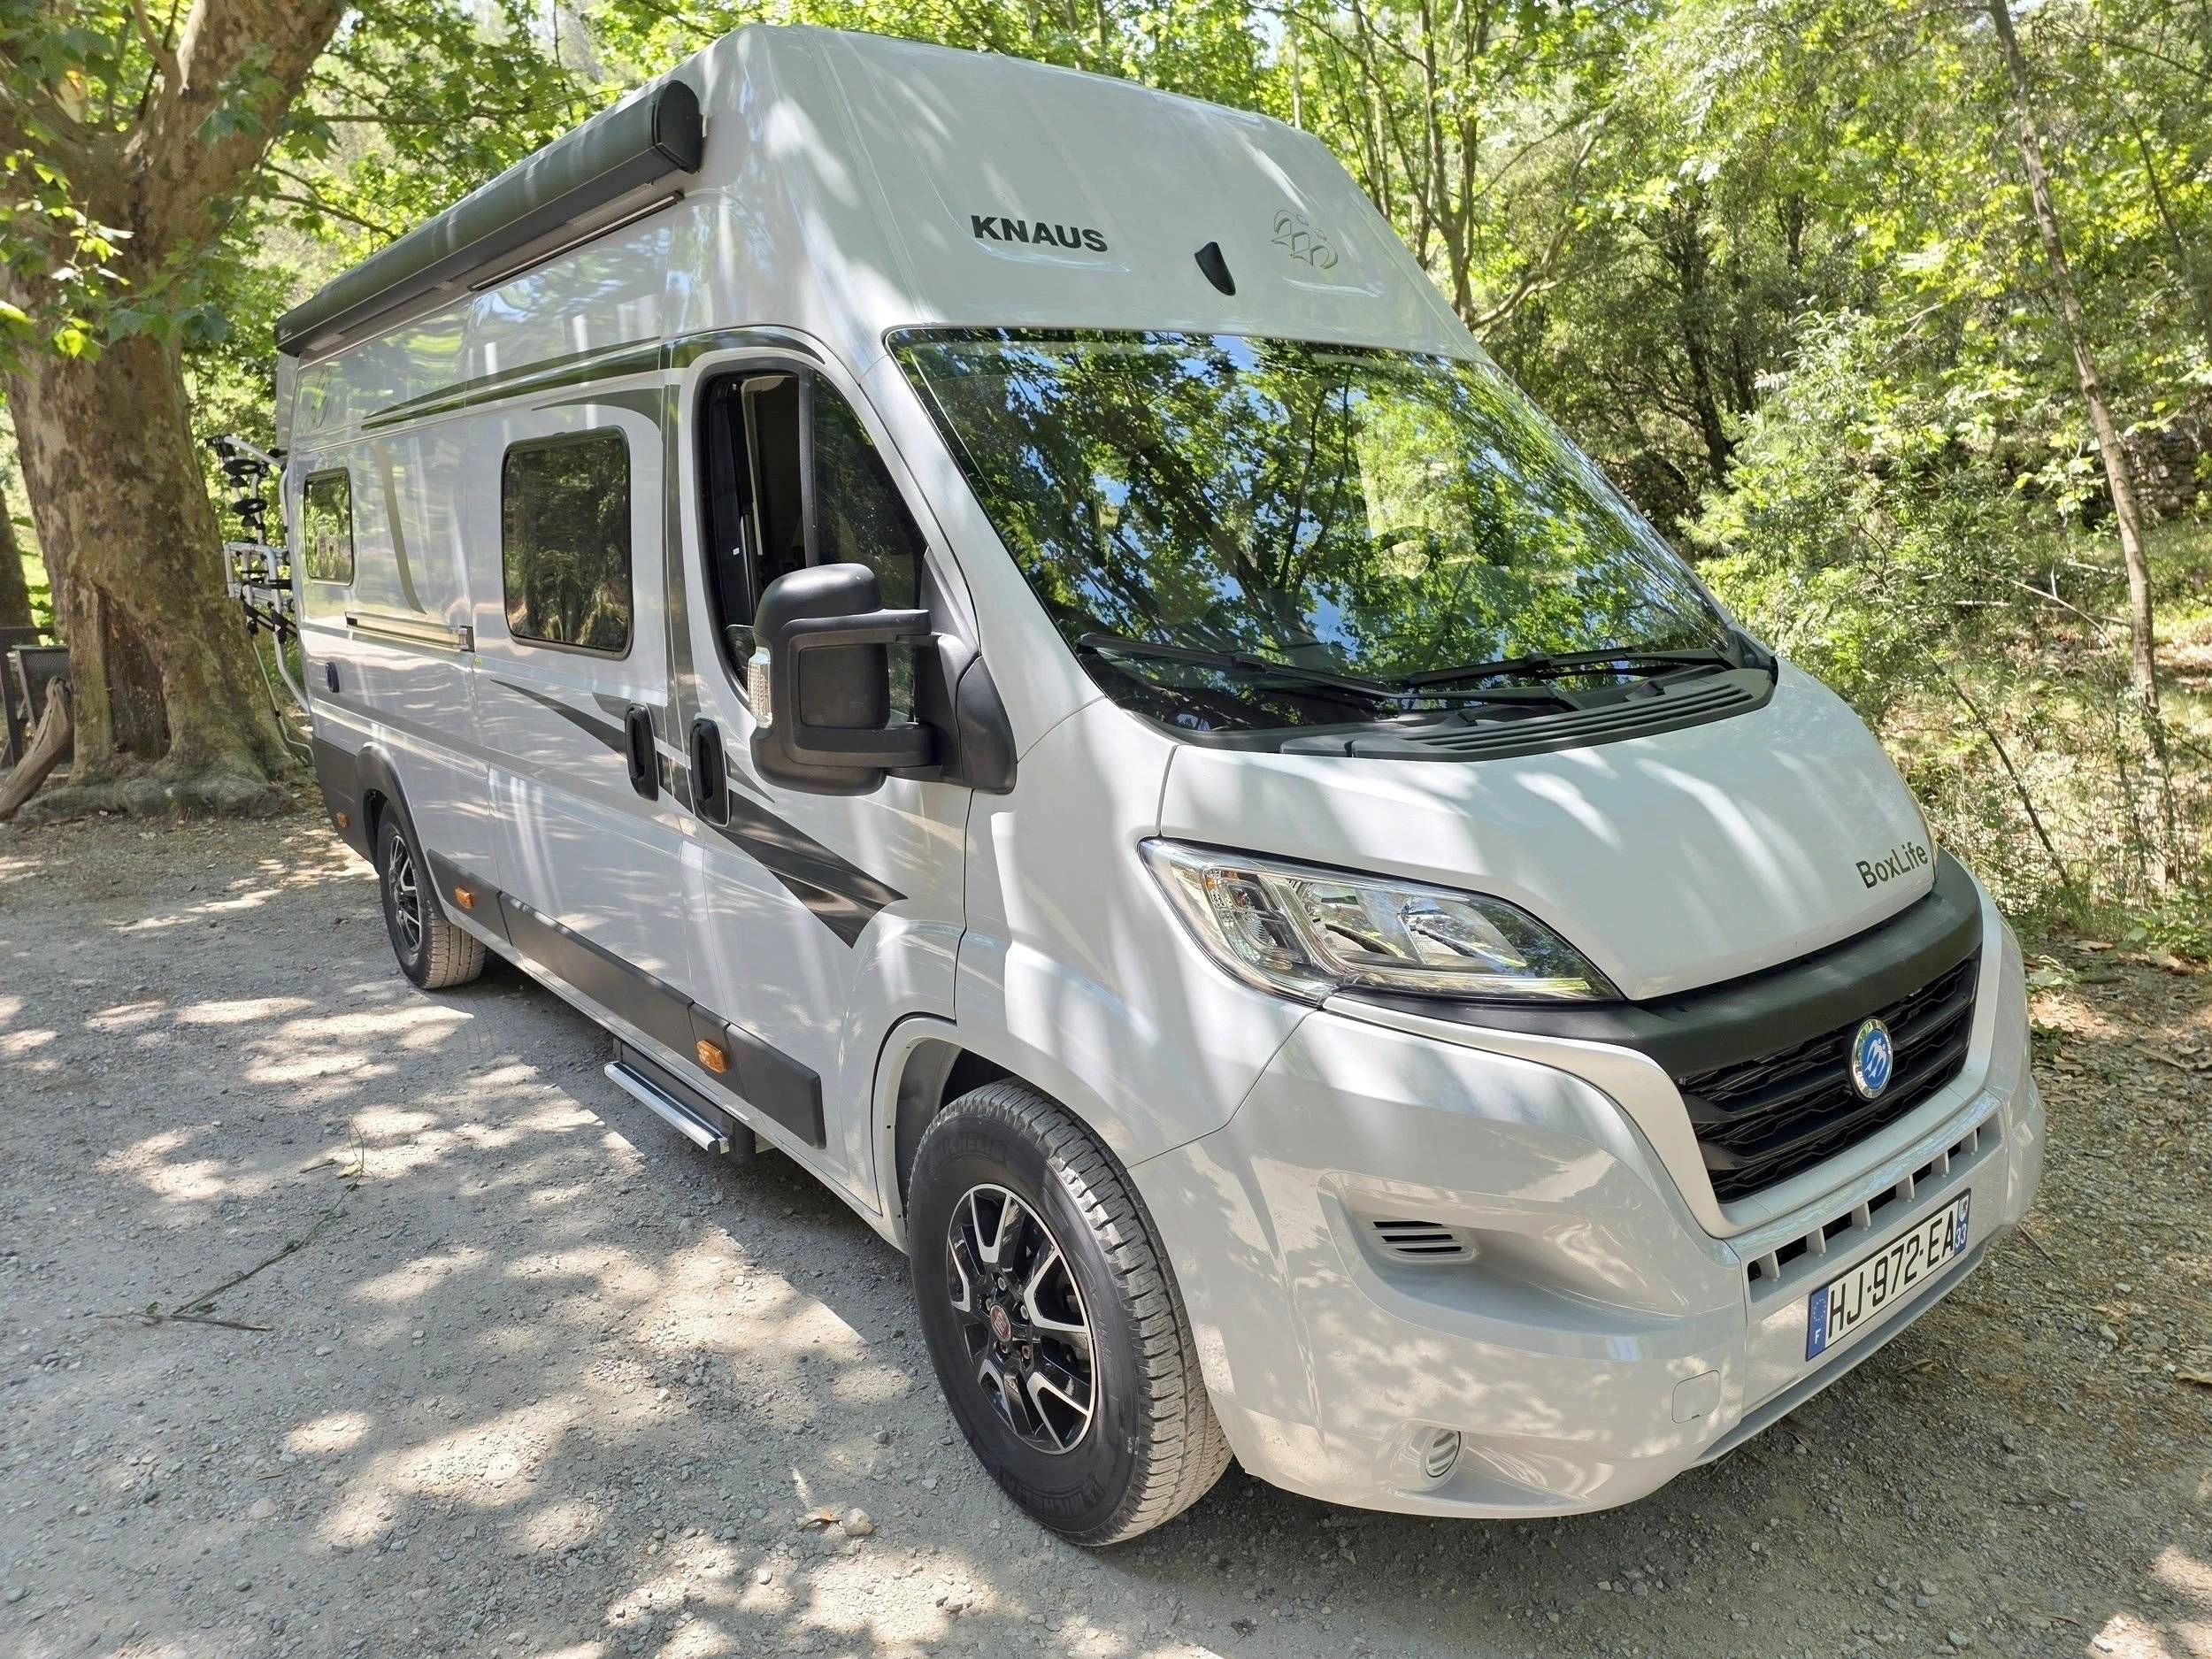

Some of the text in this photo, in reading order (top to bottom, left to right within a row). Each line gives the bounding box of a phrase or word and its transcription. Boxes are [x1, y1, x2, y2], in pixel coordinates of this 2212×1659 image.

[971, 215, 1108, 252] KNAUS
[1855, 841, 1928, 888] BoxLife
[1955, 1223, 1967, 1248] 33
[1814, 1329, 1822, 1345] F
